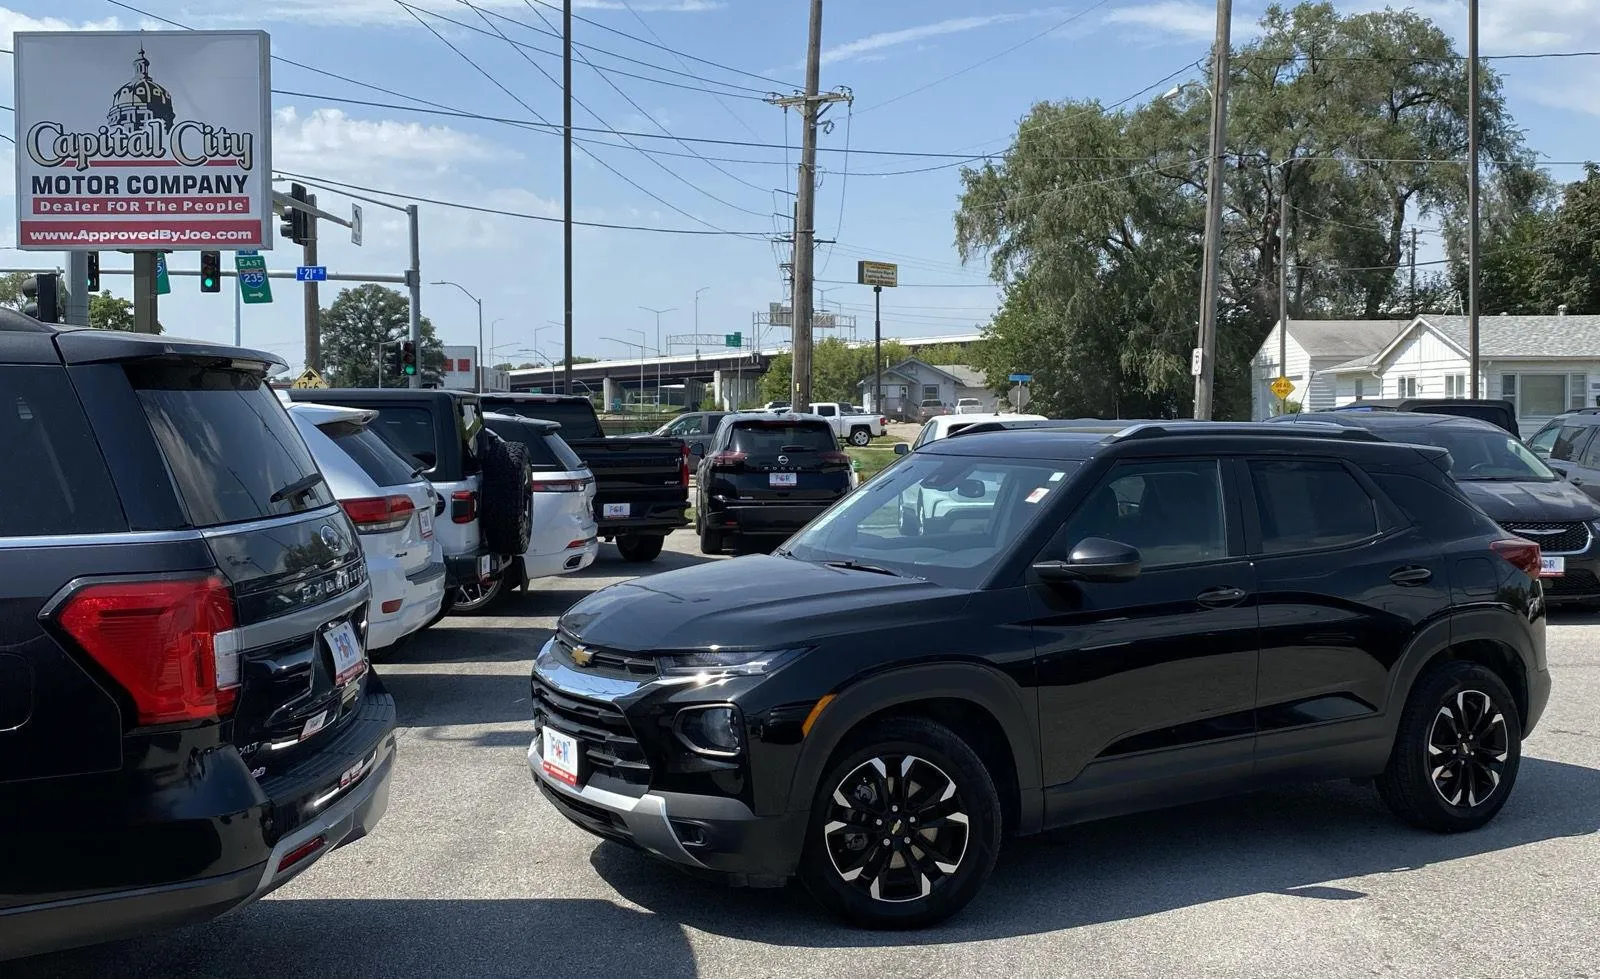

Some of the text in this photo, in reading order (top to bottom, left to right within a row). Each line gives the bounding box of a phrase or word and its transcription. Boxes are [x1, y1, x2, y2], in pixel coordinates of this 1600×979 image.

[27, 120, 253, 172] Capital City
[32, 174, 249, 195] MOTOR COMPANY
[40, 199, 244, 213] Dealer FOR The People
[29, 229, 252, 242] www.ApprovedByJoe.com
[243, 273, 264, 283] 235
